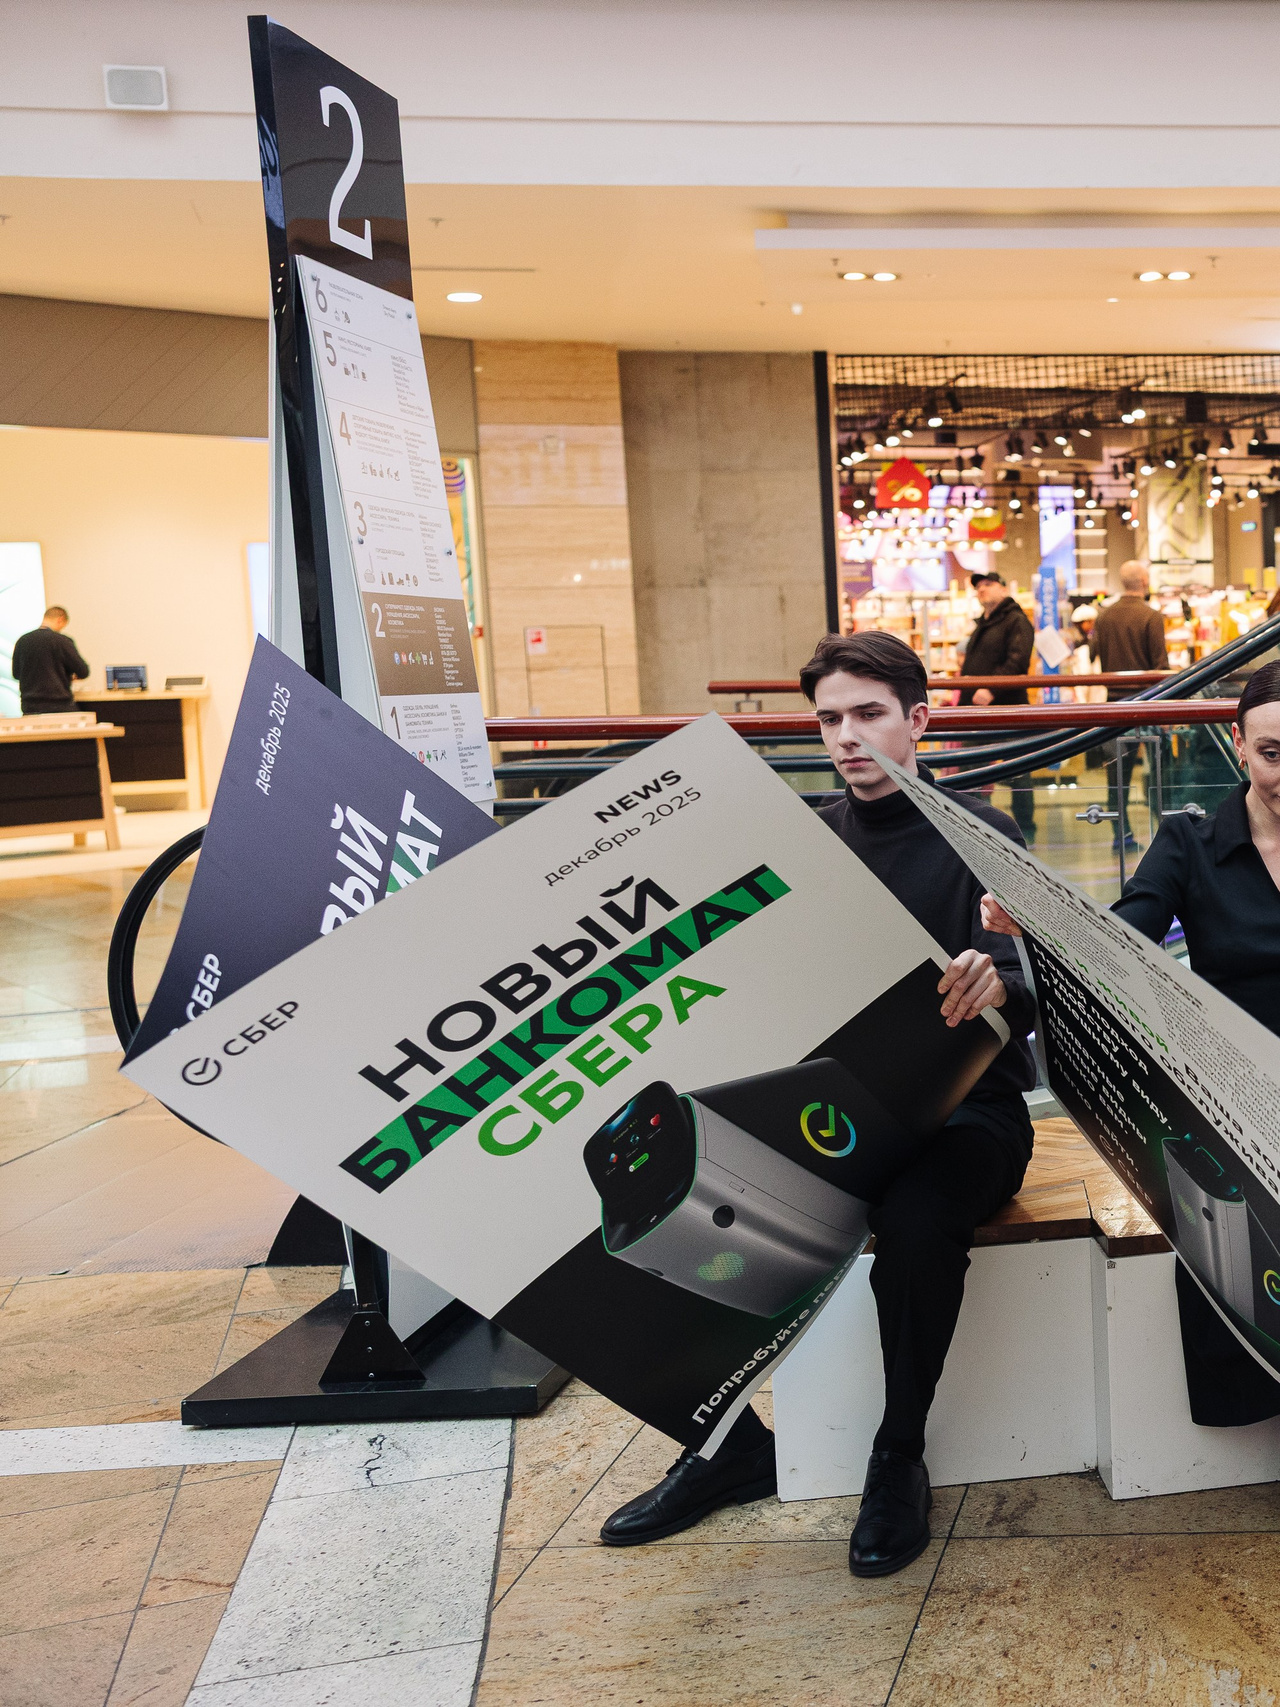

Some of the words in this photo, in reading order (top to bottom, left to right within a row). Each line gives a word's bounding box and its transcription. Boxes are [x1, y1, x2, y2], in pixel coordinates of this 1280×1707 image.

[319, 84, 374, 261] 2
[314, 277, 329, 314] 6
[322, 330, 338, 367] 5
[338, 411, 352, 447] 4
[353, 500, 368, 537] 3
[371, 602, 386, 638] 2
[255, 727, 286, 796] декабрь
[274, 681, 293, 729] 2025
[389, 705, 402, 740] 1
[544, 821, 642, 888] декабрь
[640, 786, 703, 829] 2025
[593, 769, 683, 826] NEWS
[319, 802, 389, 938] ВЫЙ
[893, 769, 1144, 952] ЗНАКОМЬТЕСЬ
[185, 952, 224, 1023] СБЕР
[222, 1000, 302, 1058] СБЕР
[339, 863, 779, 1194] БАНКОМАТ
[357, 874, 681, 1104] НОВЫЙ
[1002, 903, 1154, 1051] комфортного
[1031, 942, 1088, 1006] Новый
[1091, 1004, 1150, 1076] подход
[1036, 958, 1049, 973] к
[1052, 972, 1120, 1053] удобству
[476, 973, 728, 1157] СБЕРА
[1040, 973, 1051, 988] и
[1054, 987, 1129, 1078] внешнему
[1131, 1079, 1172, 1131] виду.
[1046, 1000, 1125, 1103] Приватные
[1048, 1017, 1099, 1084] данные
[1101, 1083, 1147, 1145] видны
[1050, 1029, 1096, 1093] только
[1098, 1092, 1129, 1135] вам.
[1075, 956, 1090, 975] и
[1096, 975, 1178, 1063] живой.
[1184, 1062, 1244, 1136] Ваша
[1053, 1056, 1093, 1111] Легко
[1095, 1112, 1139, 1172] найти.
[1117, 1158, 1153, 1206] СБЕР
[691, 1307, 811, 1426] Попробуйте
